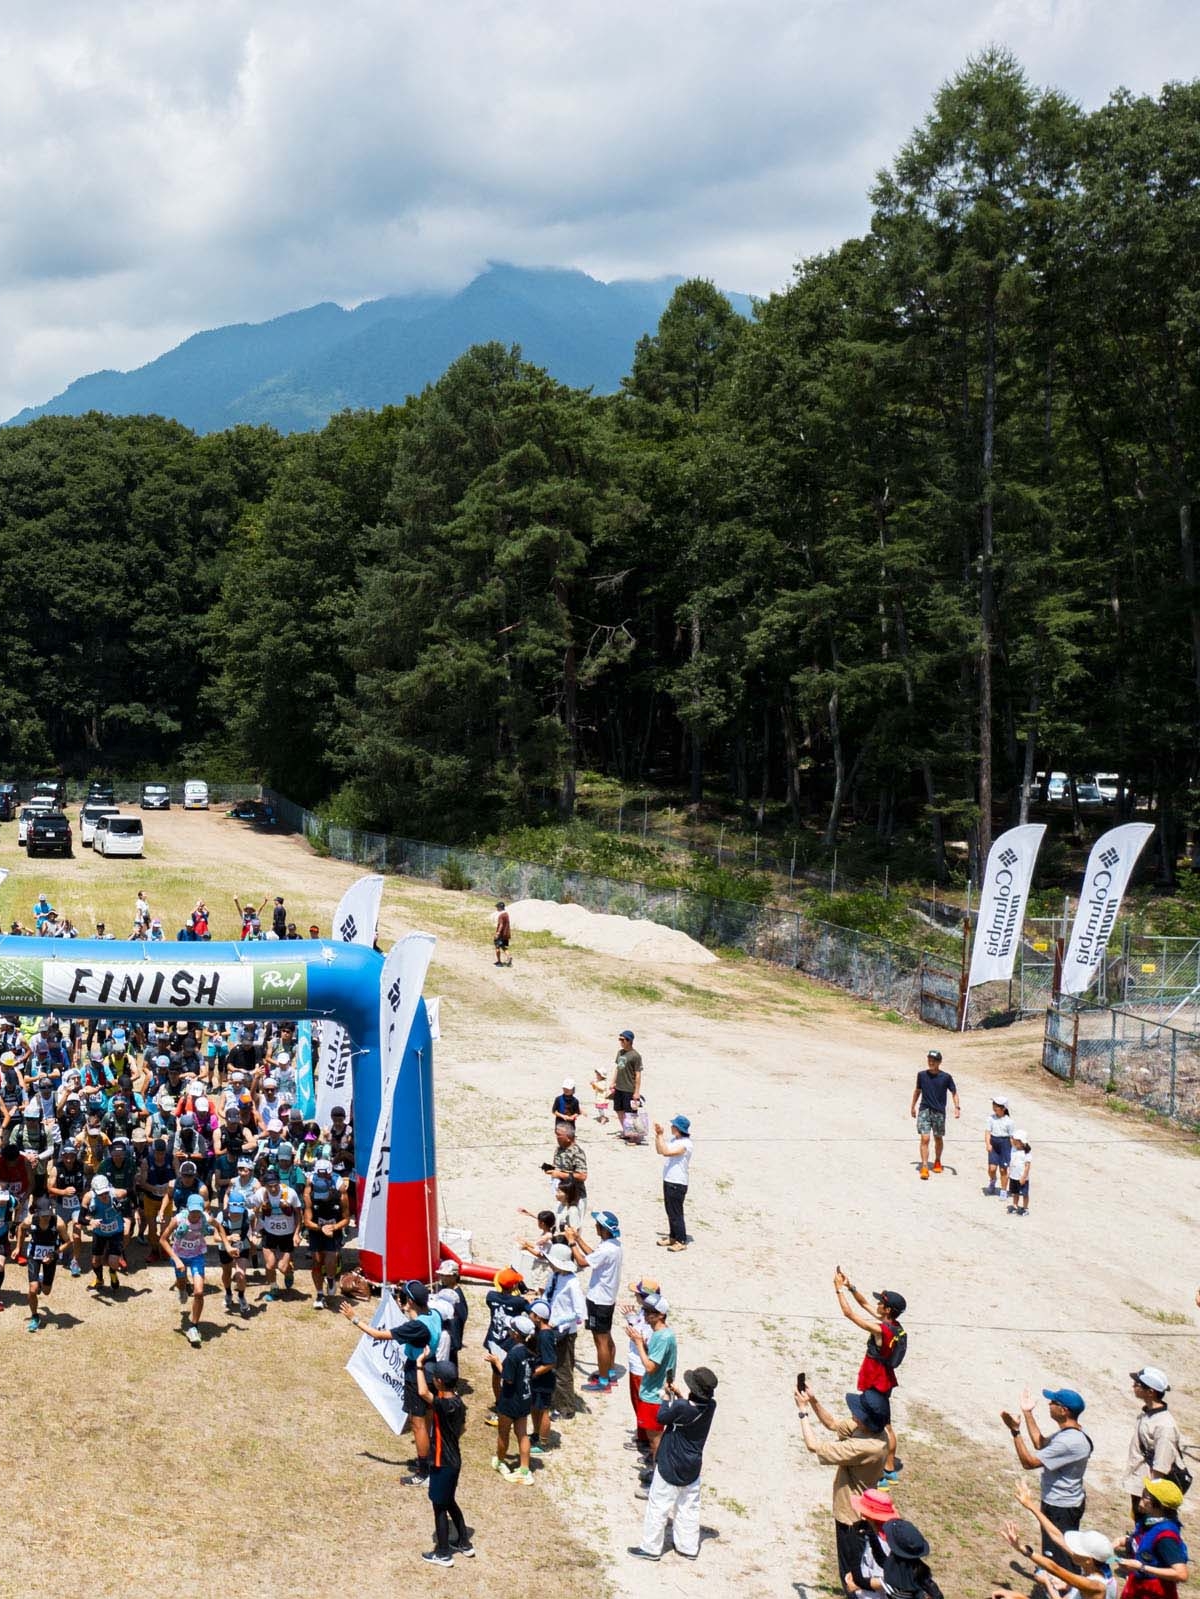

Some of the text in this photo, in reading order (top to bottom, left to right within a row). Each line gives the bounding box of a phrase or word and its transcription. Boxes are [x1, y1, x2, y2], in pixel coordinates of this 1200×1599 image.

[68, 967, 221, 1007] FINISH
[260, 996, 302, 1008] Lamplan
[270, 1221, 288, 1230] 263
